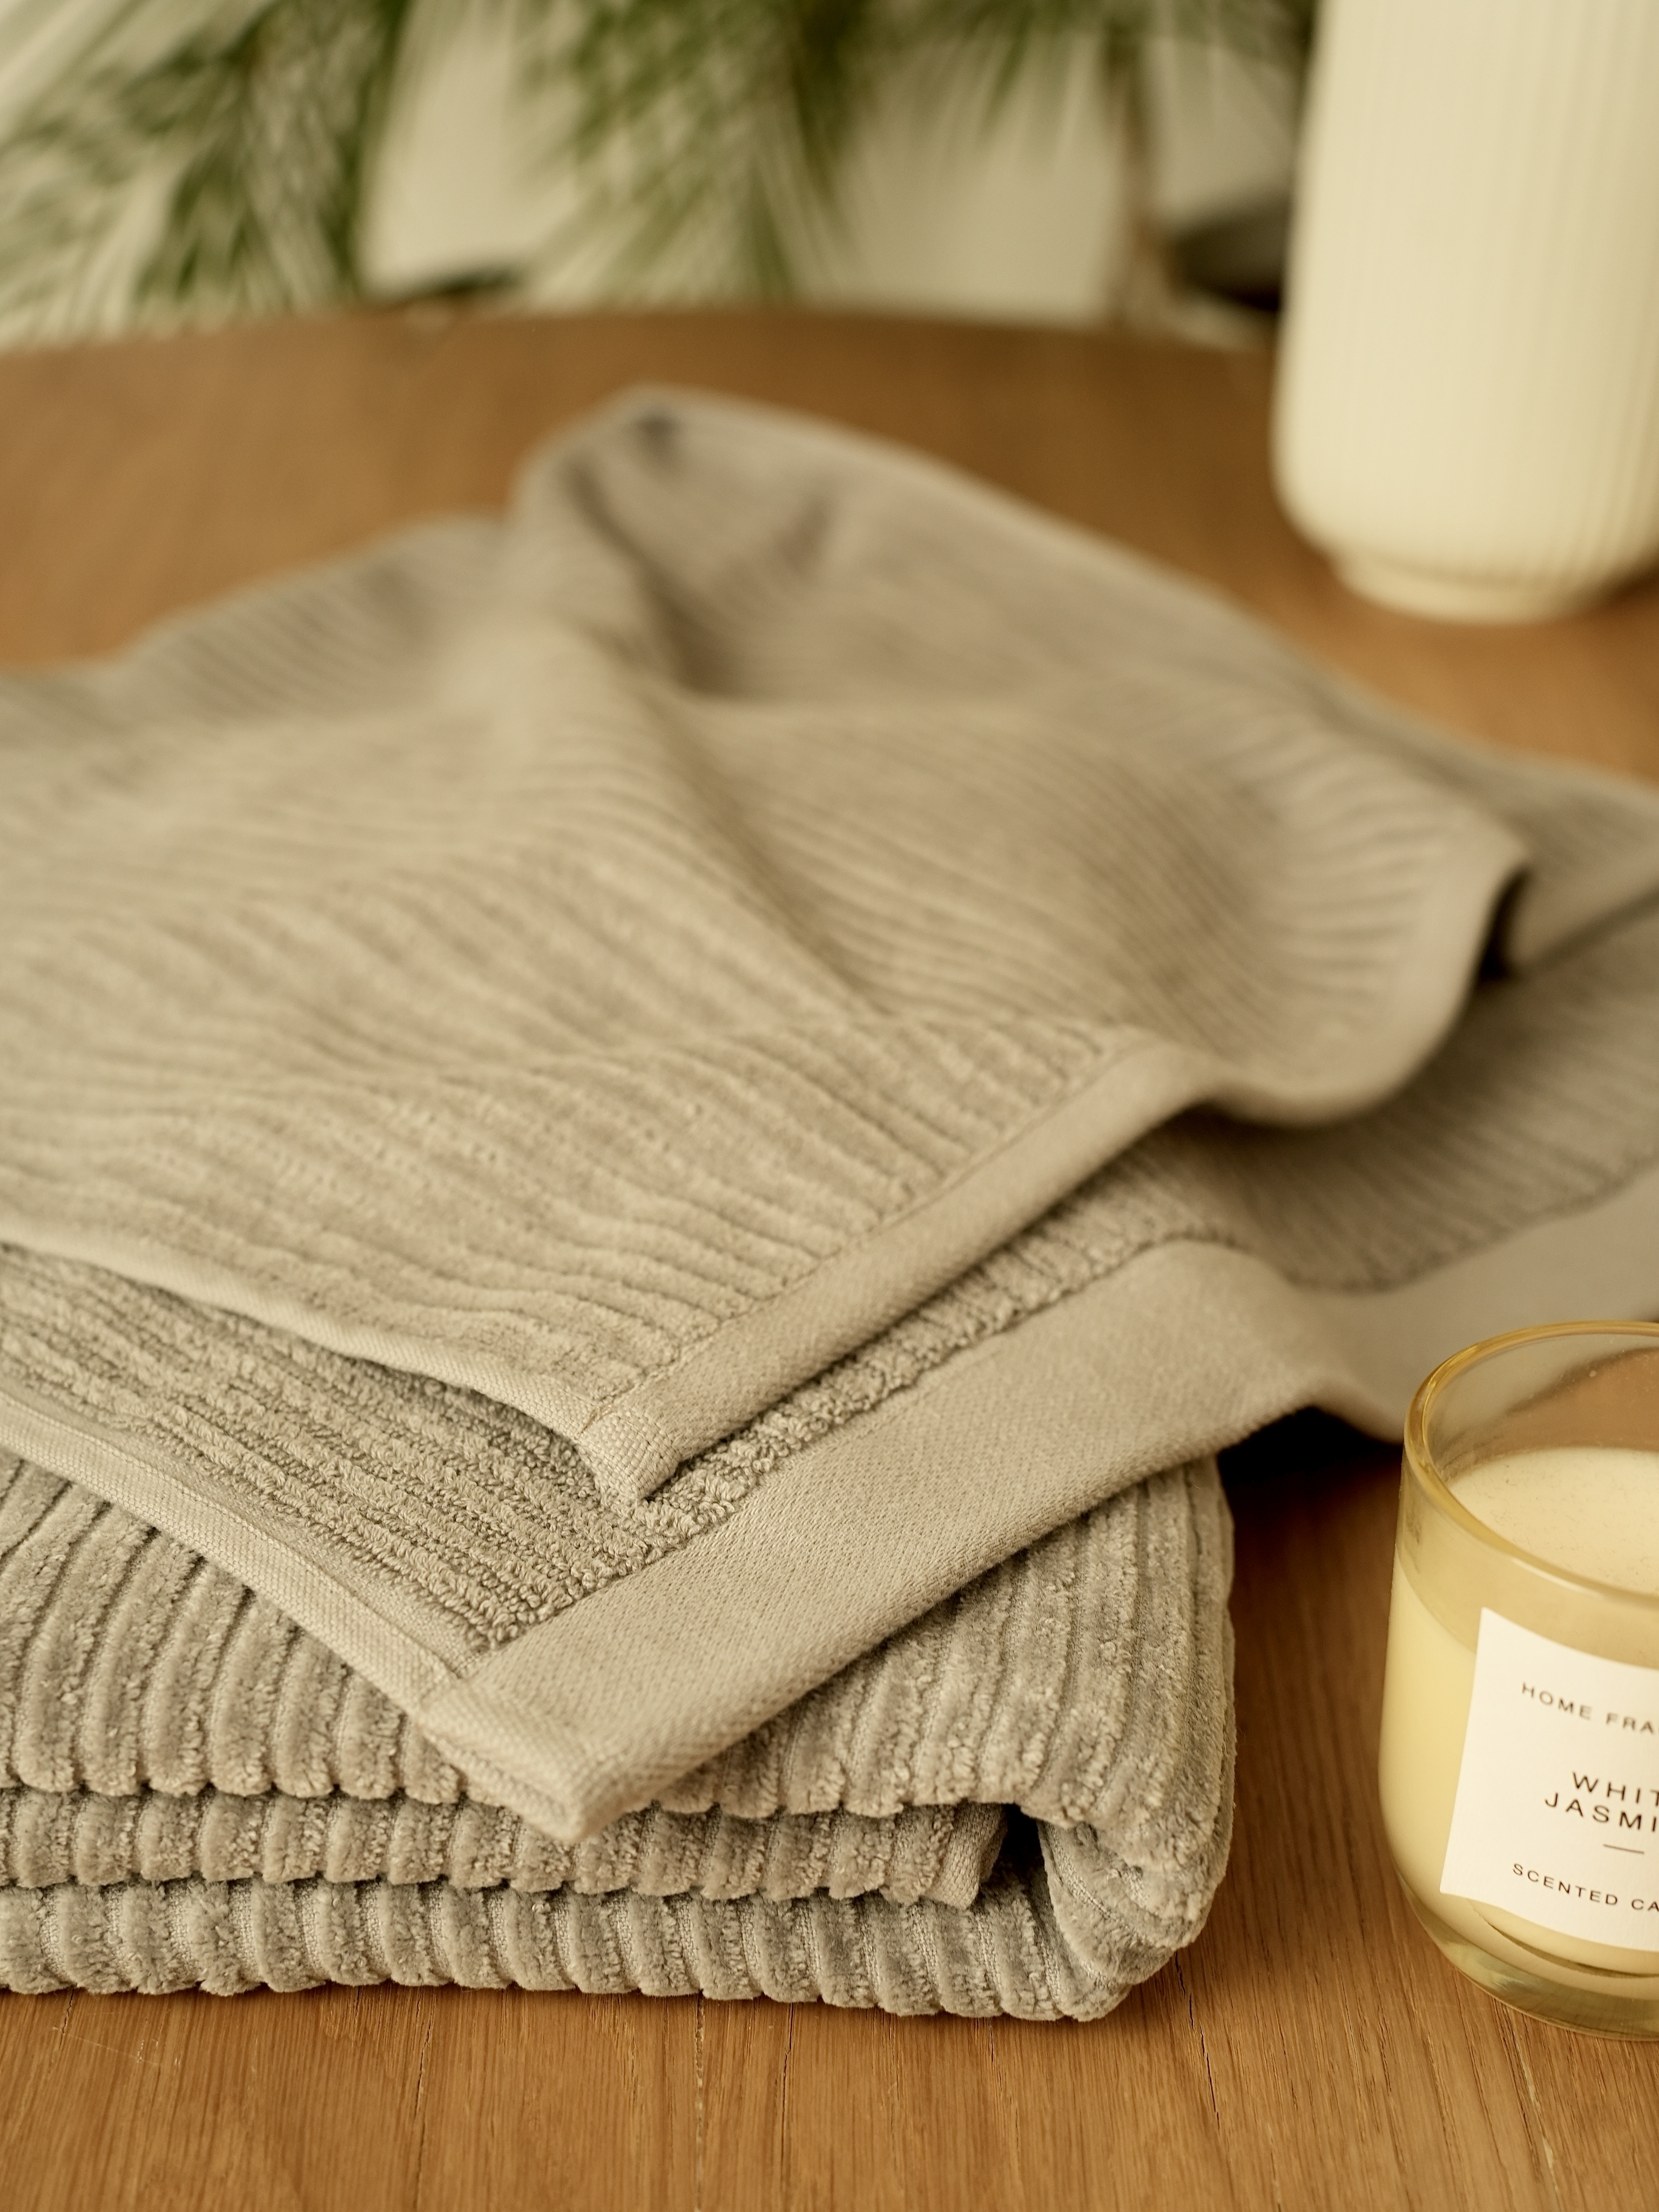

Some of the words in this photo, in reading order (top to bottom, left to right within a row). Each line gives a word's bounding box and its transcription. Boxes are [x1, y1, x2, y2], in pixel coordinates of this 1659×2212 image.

[1521, 1682, 1591, 1721] HOME
[1606, 1712, 1659, 1735] FRA
[1572, 1771, 1659, 1808] WHIT
[1544, 1792, 1657, 1833] JASMI
[1512, 1863, 1618, 1906] SCENTED
[1630, 1898, 1659, 1913] CA
